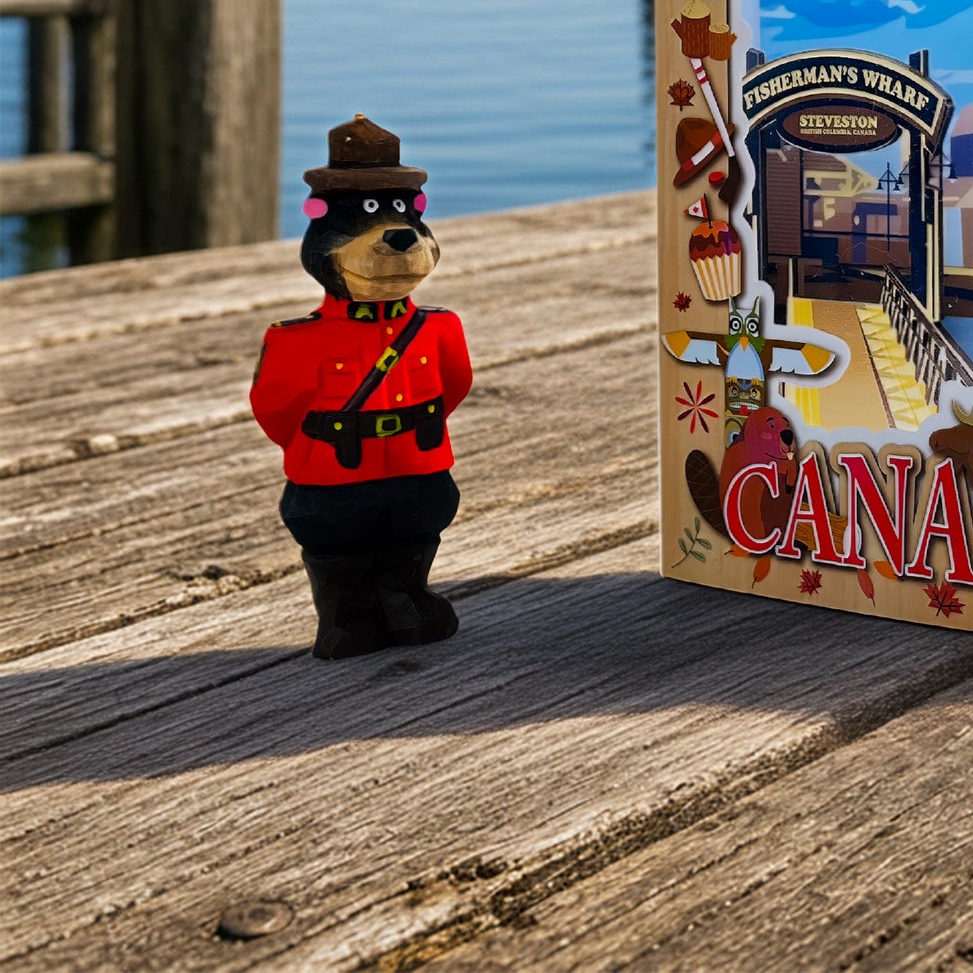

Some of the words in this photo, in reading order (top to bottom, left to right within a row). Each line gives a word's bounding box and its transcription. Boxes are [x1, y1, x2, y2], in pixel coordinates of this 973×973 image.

[743, 65, 859, 110] FISHERMAN'S
[862, 69, 929, 111] WHARF
[799, 114, 878, 129] STEVESTON
